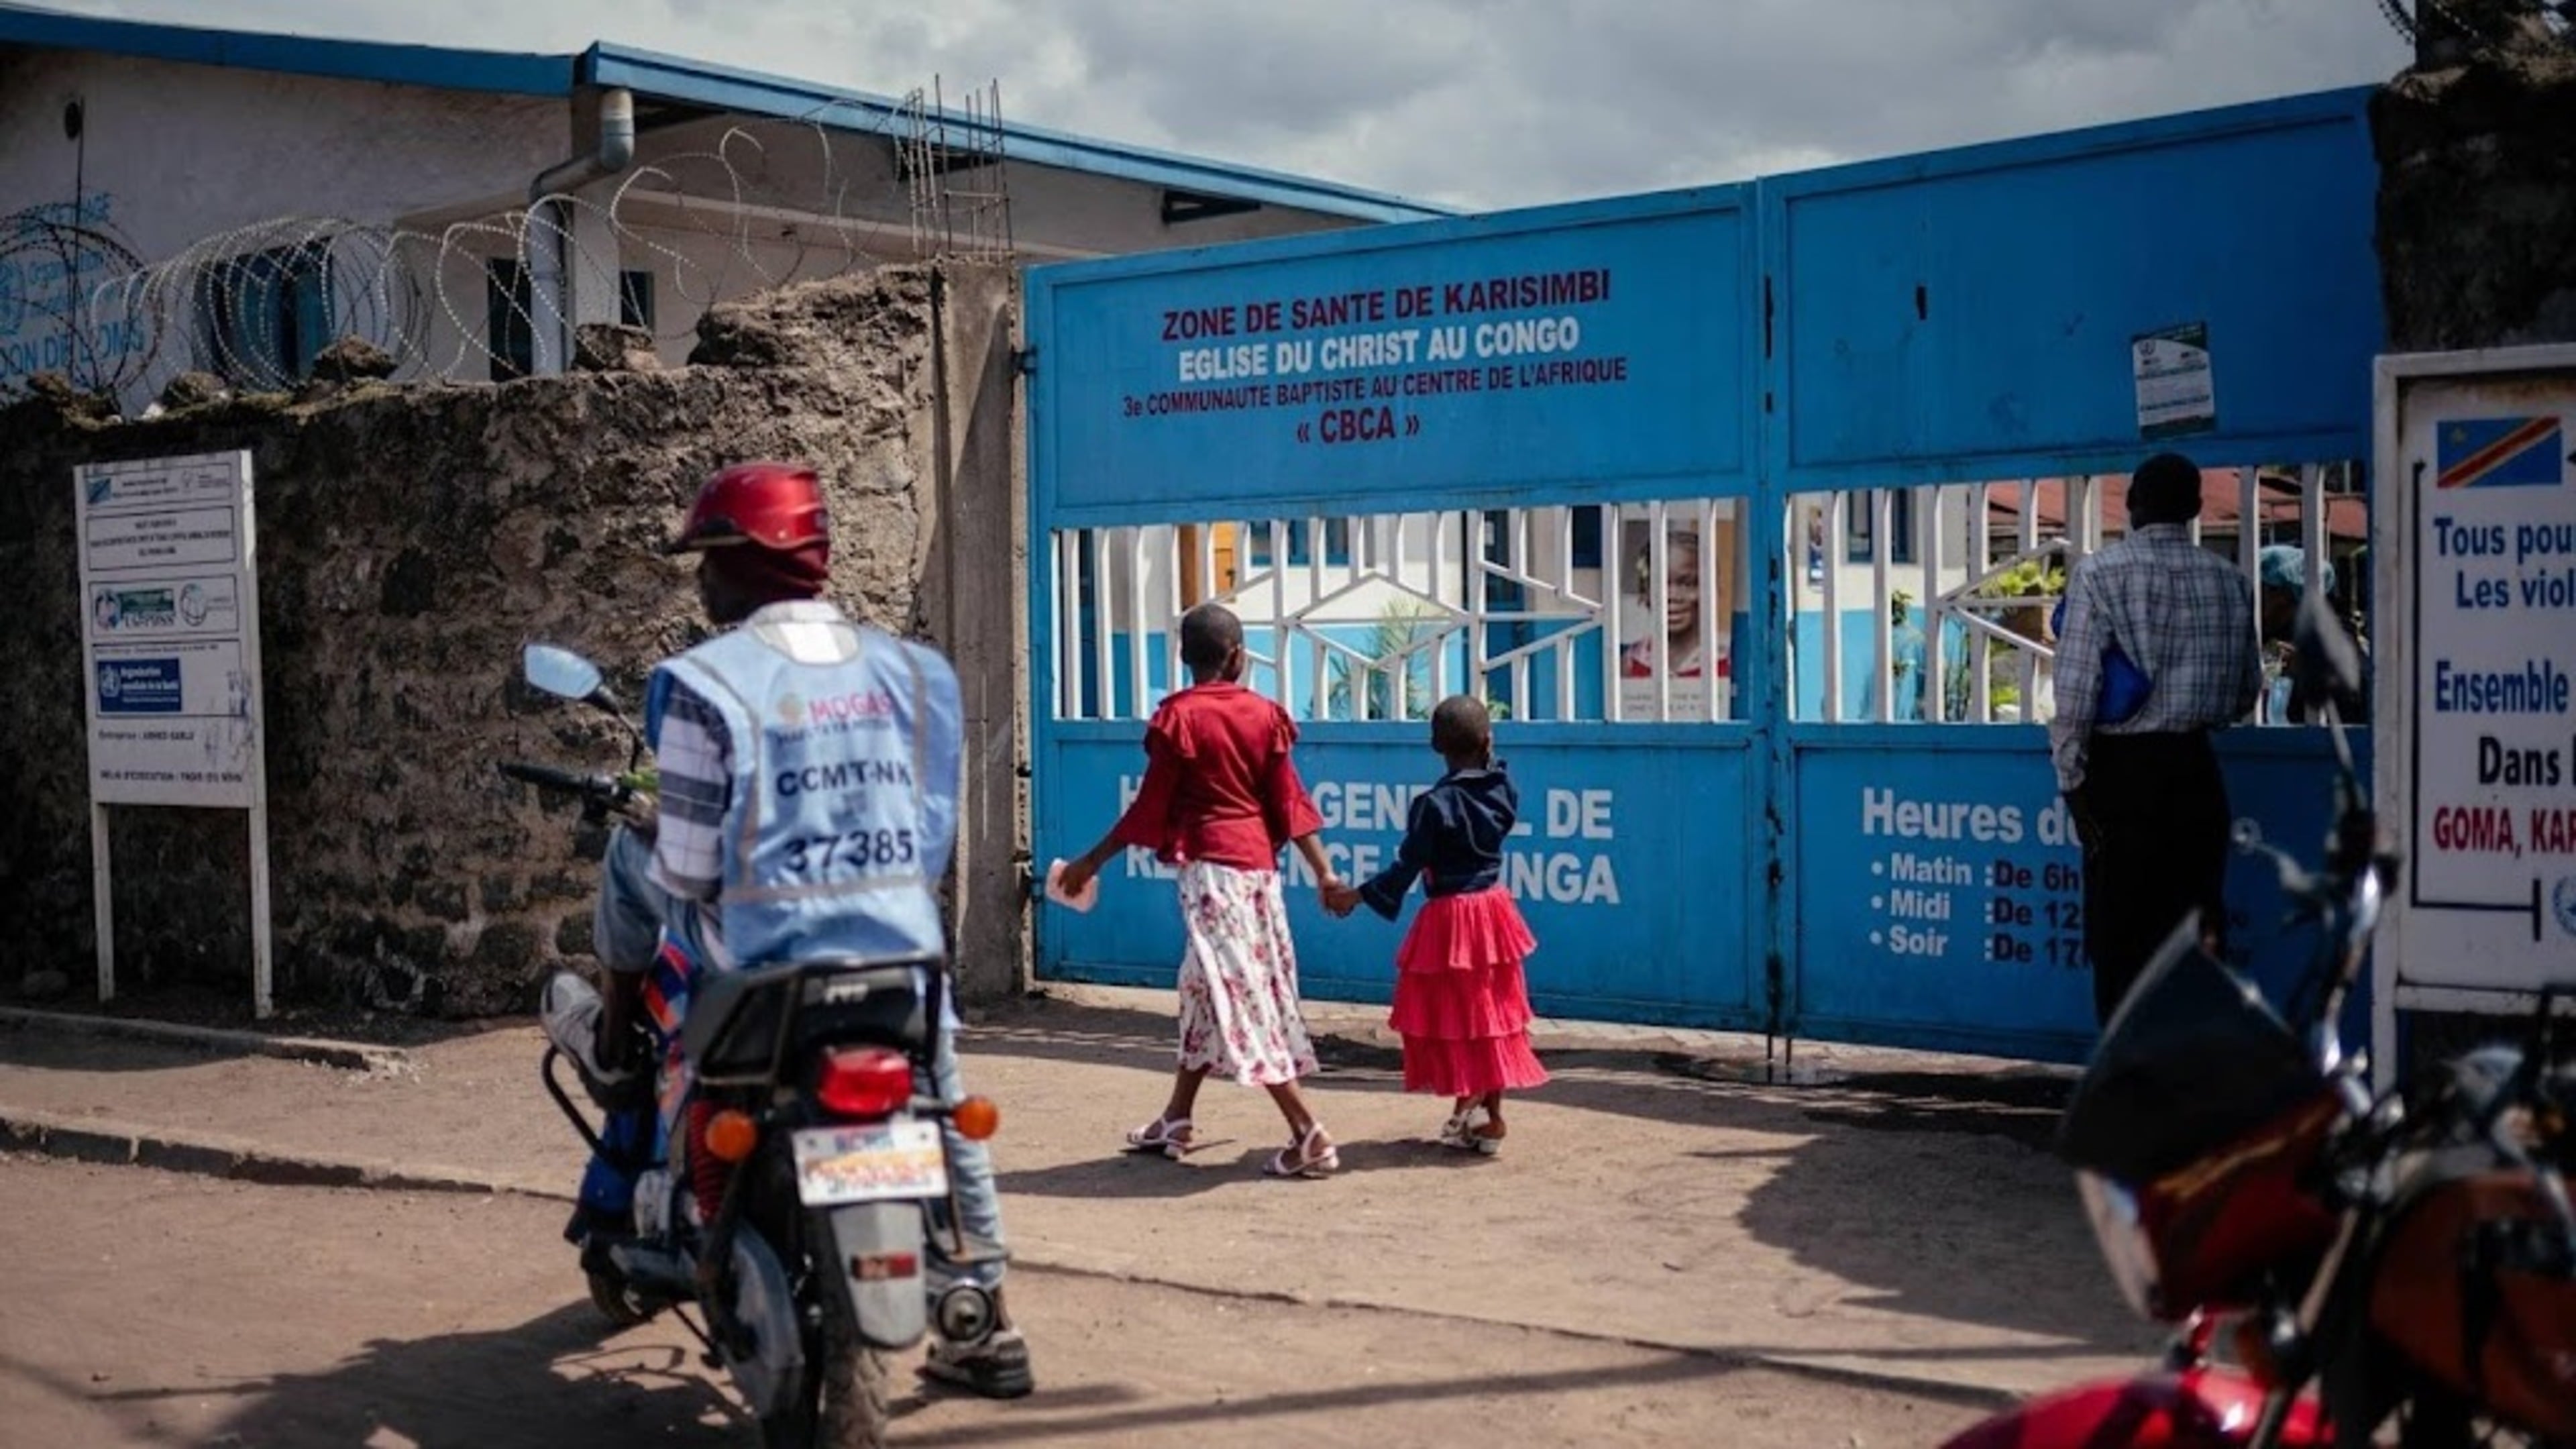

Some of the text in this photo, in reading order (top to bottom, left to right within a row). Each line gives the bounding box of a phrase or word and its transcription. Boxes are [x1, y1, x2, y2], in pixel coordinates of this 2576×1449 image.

[1162, 270, 1609, 341] ZONE DE SANTE DE KARISIMBI
[1179, 316, 1579, 382] EGLISE DU CHRIST AU CONGO
[1124, 357, 1627, 417] 3e COMMUNAUTE BAPTISTE AU CENTRE DE L'AFRIQUE
[1320, 406, 1396, 444] CBCA
[2434, 517, 2505, 555] Tous
[2457, 570, 2510, 608] Les
[2435, 659, 2568, 712] Ensemble
[2479, 736, 2561, 785] Dans
[1547, 789, 1613, 839] DE
[1863, 787, 2024, 843] Heures
[2434, 807, 2522, 859] GOMA,
[1891, 853, 1972, 885] Matin
[1890, 889, 1950, 920] Midi
[1889, 925, 1948, 956] Soir
